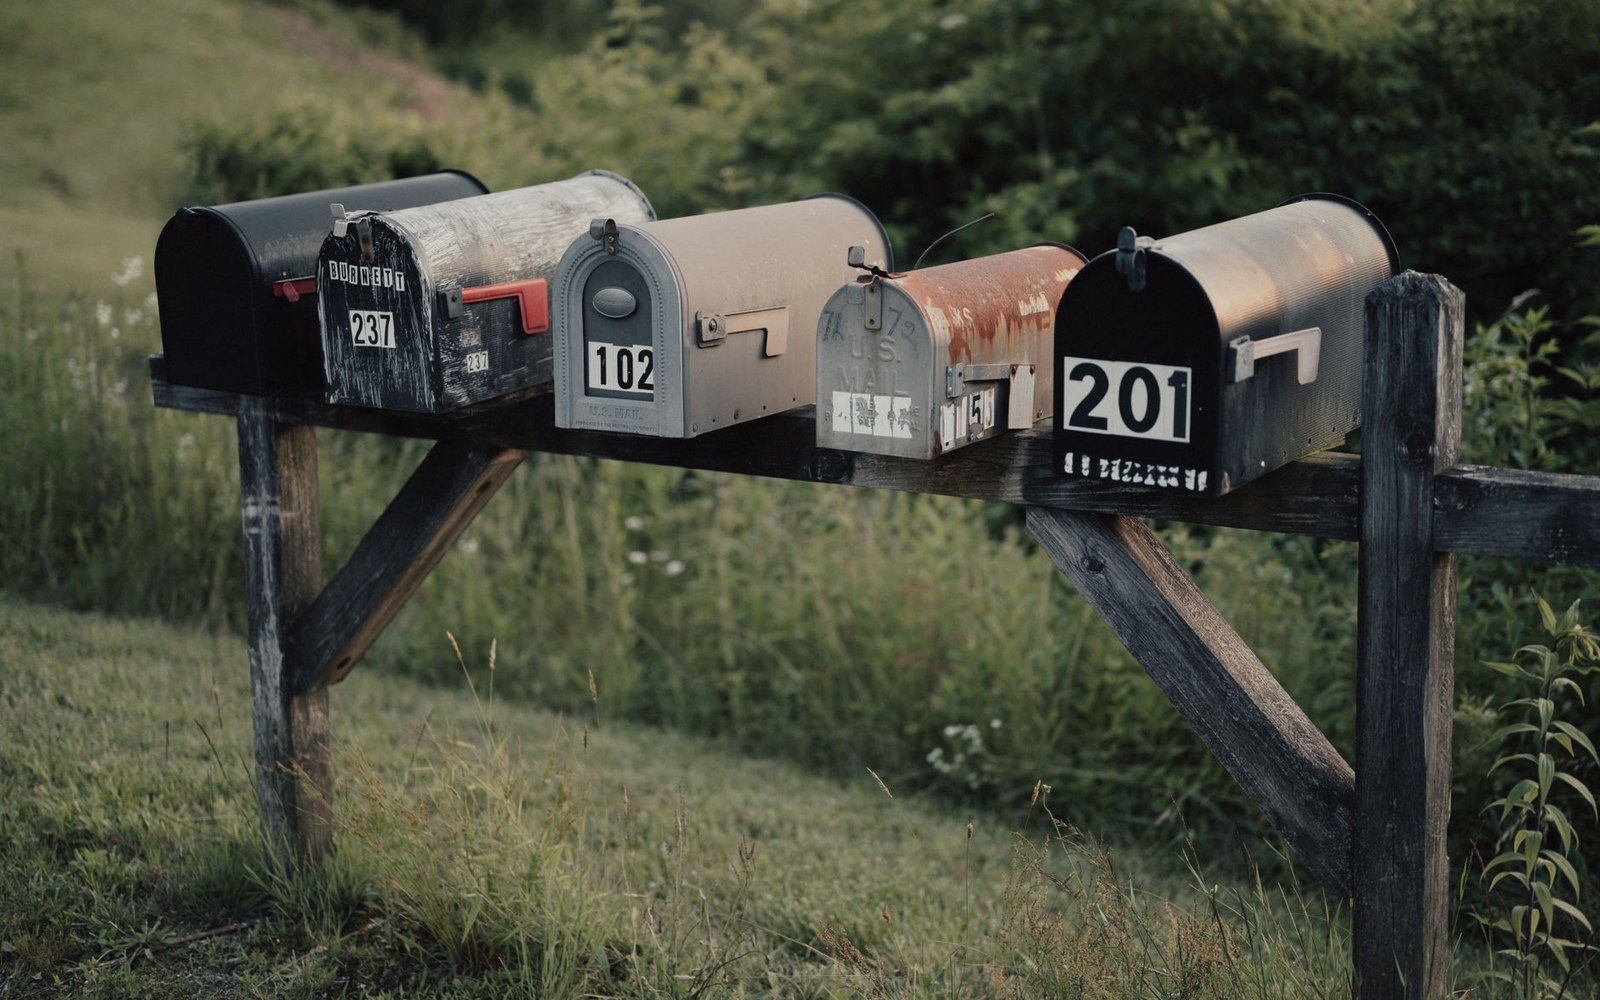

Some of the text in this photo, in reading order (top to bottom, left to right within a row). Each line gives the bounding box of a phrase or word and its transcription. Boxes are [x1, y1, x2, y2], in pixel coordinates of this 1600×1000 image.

[330, 261, 405, 291] BURNETT
[351, 312, 391, 346] 237
[468, 352, 487, 371] 237
[596, 346, 655, 390] 102
[1068, 362, 1189, 439] 201
